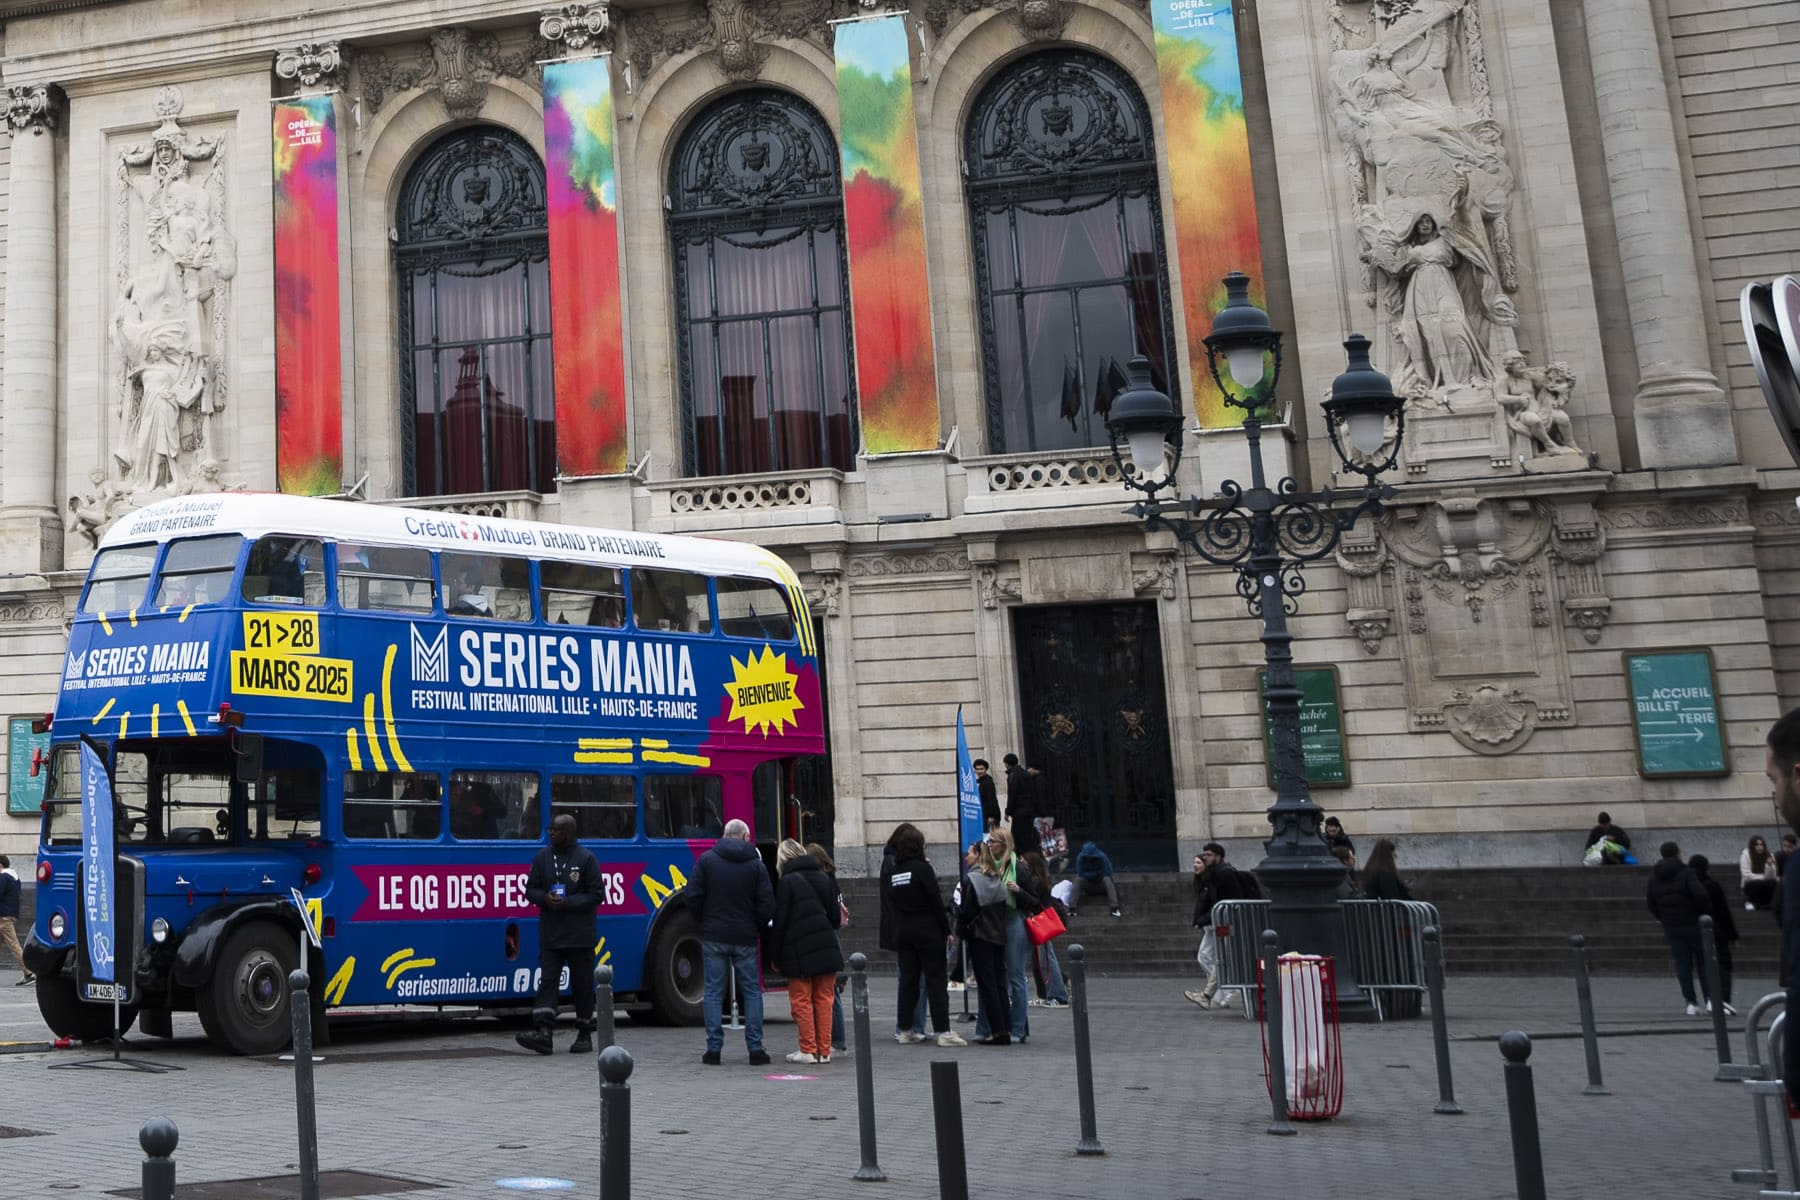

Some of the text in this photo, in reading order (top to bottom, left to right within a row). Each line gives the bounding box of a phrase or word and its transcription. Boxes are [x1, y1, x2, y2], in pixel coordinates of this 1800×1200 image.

[1188, 15, 1215, 28] LILLE
[301, 134, 322, 145] LILLE
[182, 499, 225, 513] Mutuel
[129, 513, 218, 536] GRAND PARTENAIRE
[404, 515, 667, 559] Crédit Mutuel GRAND PARTENAIRE
[86, 645, 148, 678] SERIES
[150, 640, 210, 672] MANIA
[459, 629, 581, 692] SERIES
[590, 638, 698, 697] MANIA
[63, 671, 207, 691] FESTIVAL INTERNATIONAL LILLE HAUTS-DE-FRANCE
[239, 657, 349, 696] MARS 2025
[411, 690, 698, 720] FESTIVAL INTERNATIONAL LILLE HAUTS-DE-FRANCE
[737, 680, 793, 708] BIENVENUE
[1652, 687, 1711, 700] ACCUEIL
[1637, 700, 1680, 713] BILLET
[1677, 712, 1716, 724] TERIE
[378, 875, 404, 911] LE
[409, 874, 439, 913] QG
[446, 874, 487, 909] DES
[397, 971, 508, 998] seriesmania.com
